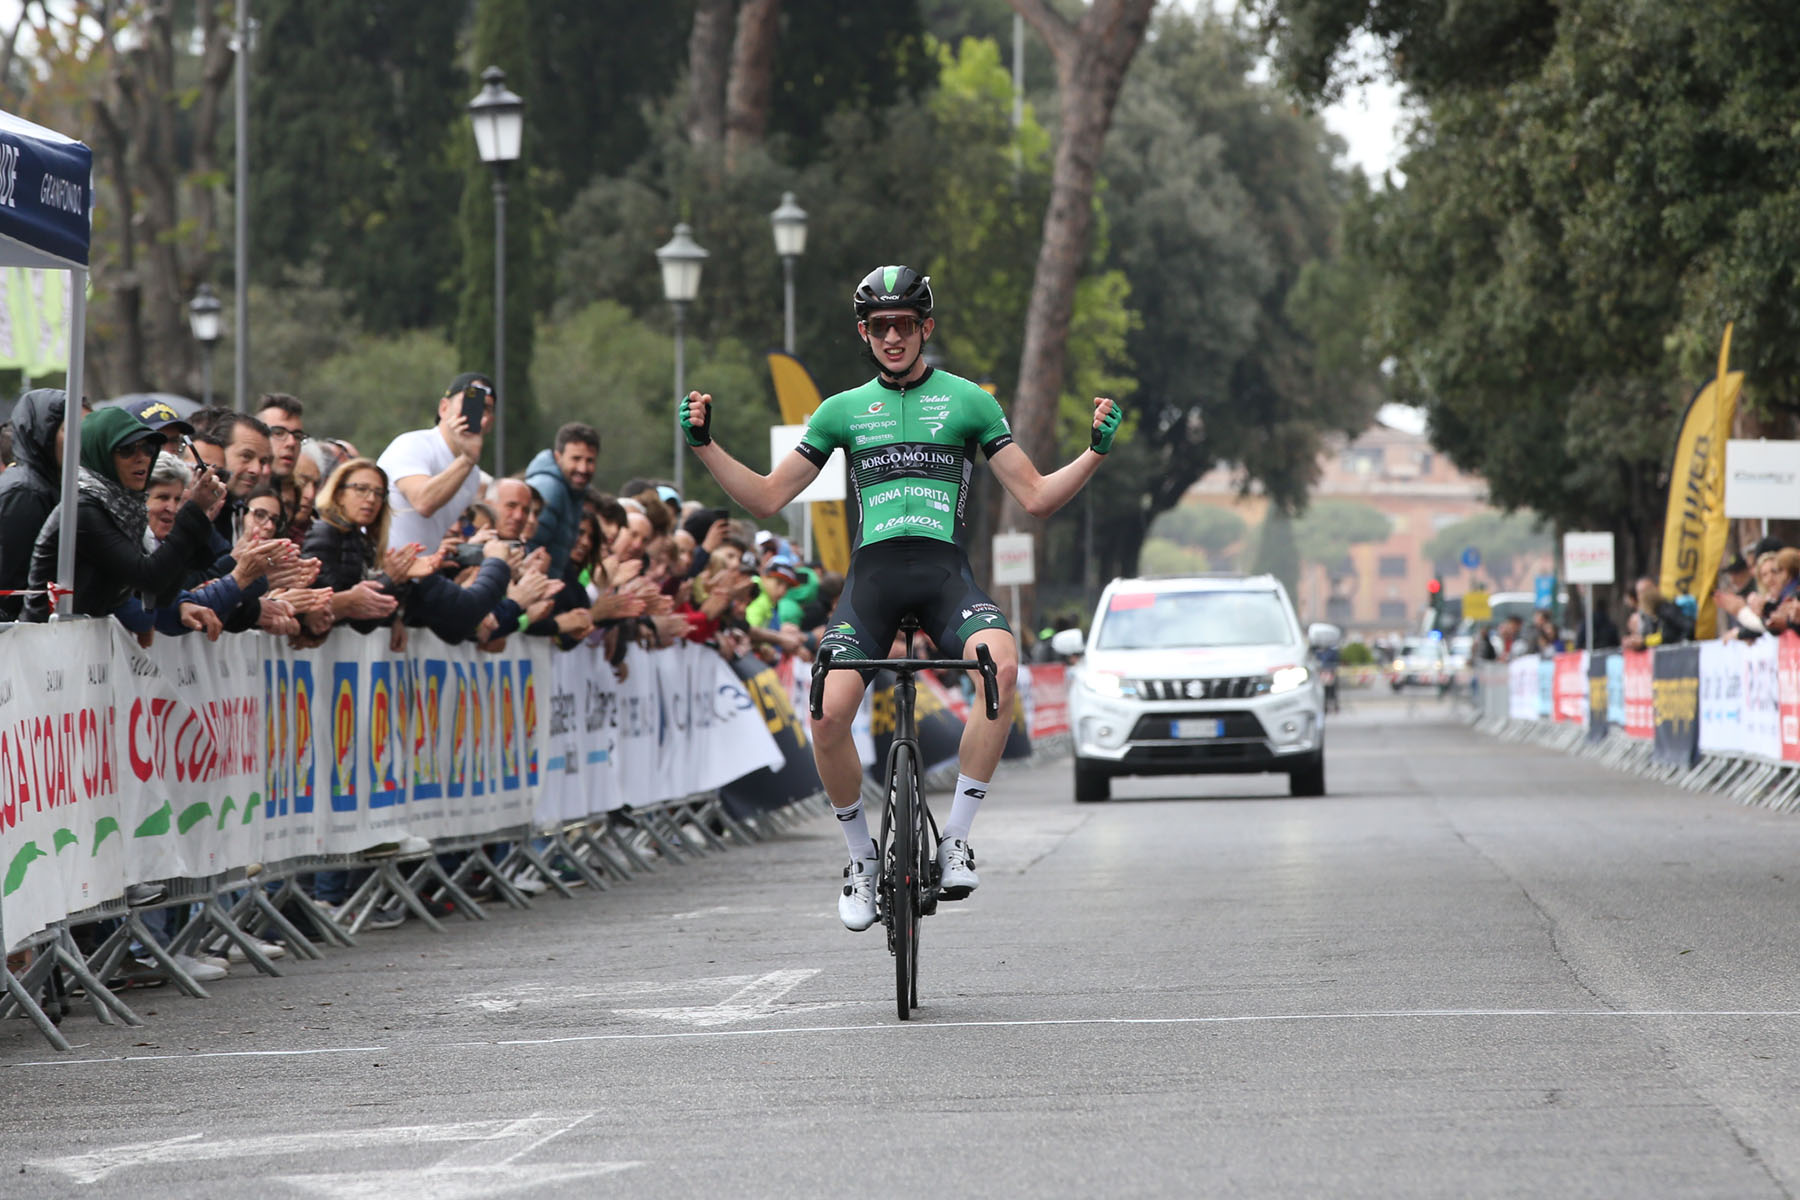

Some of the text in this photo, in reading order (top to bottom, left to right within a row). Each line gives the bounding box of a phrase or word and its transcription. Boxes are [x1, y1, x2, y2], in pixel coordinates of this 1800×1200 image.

[861, 451, 954, 470] BORGO MOLINO
[868, 488, 902, 507] VIGNA
[904, 486, 950, 504] FIORITA
[885, 515, 941, 529] RAINOX
